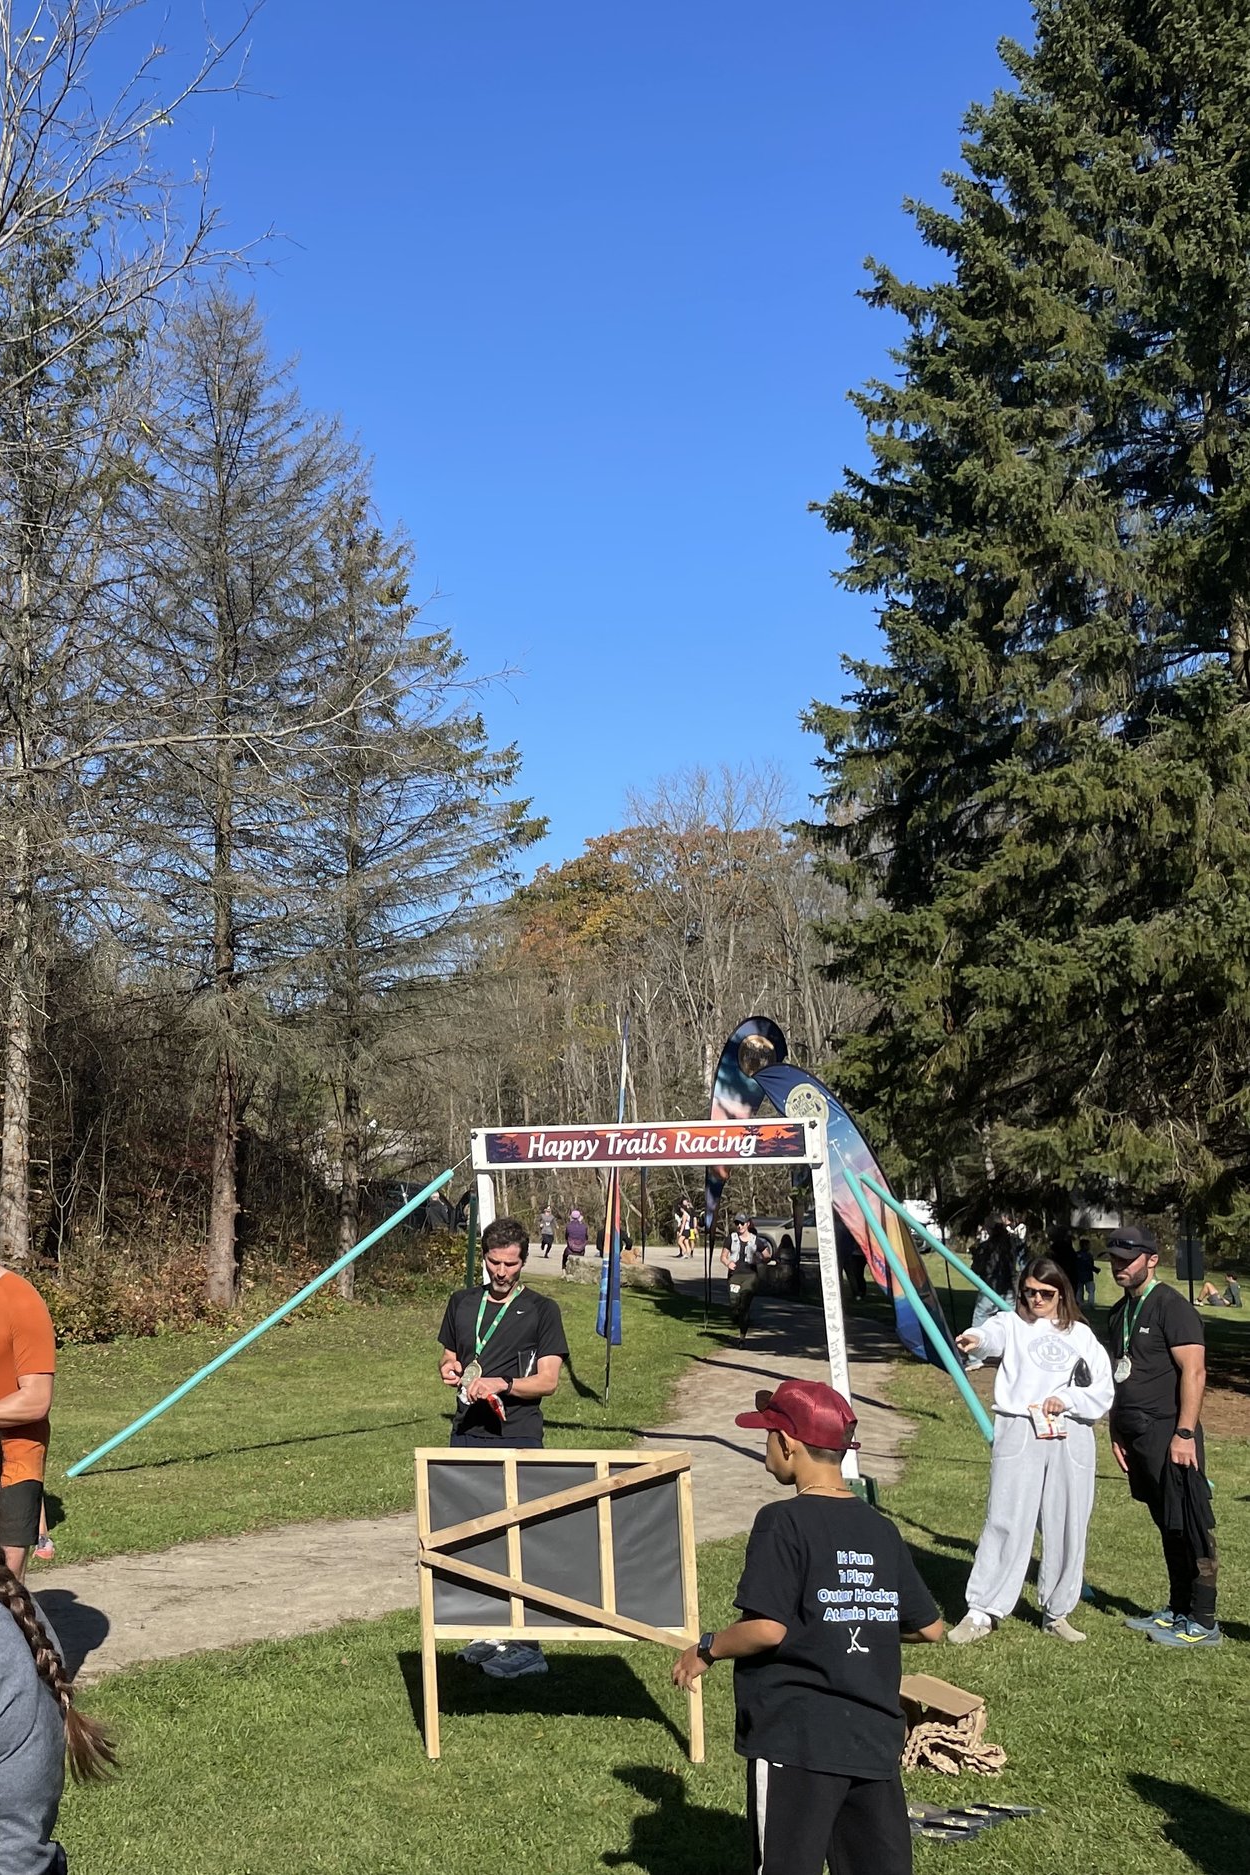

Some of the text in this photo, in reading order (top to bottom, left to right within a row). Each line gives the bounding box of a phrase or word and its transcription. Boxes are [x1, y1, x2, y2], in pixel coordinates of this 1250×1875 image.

[527, 1129, 757, 1161] Happy Trails Racing
[848, 1550, 874, 1566] Fun
[846, 1569, 874, 1587] Play
[867, 1607, 899, 1622] Park
